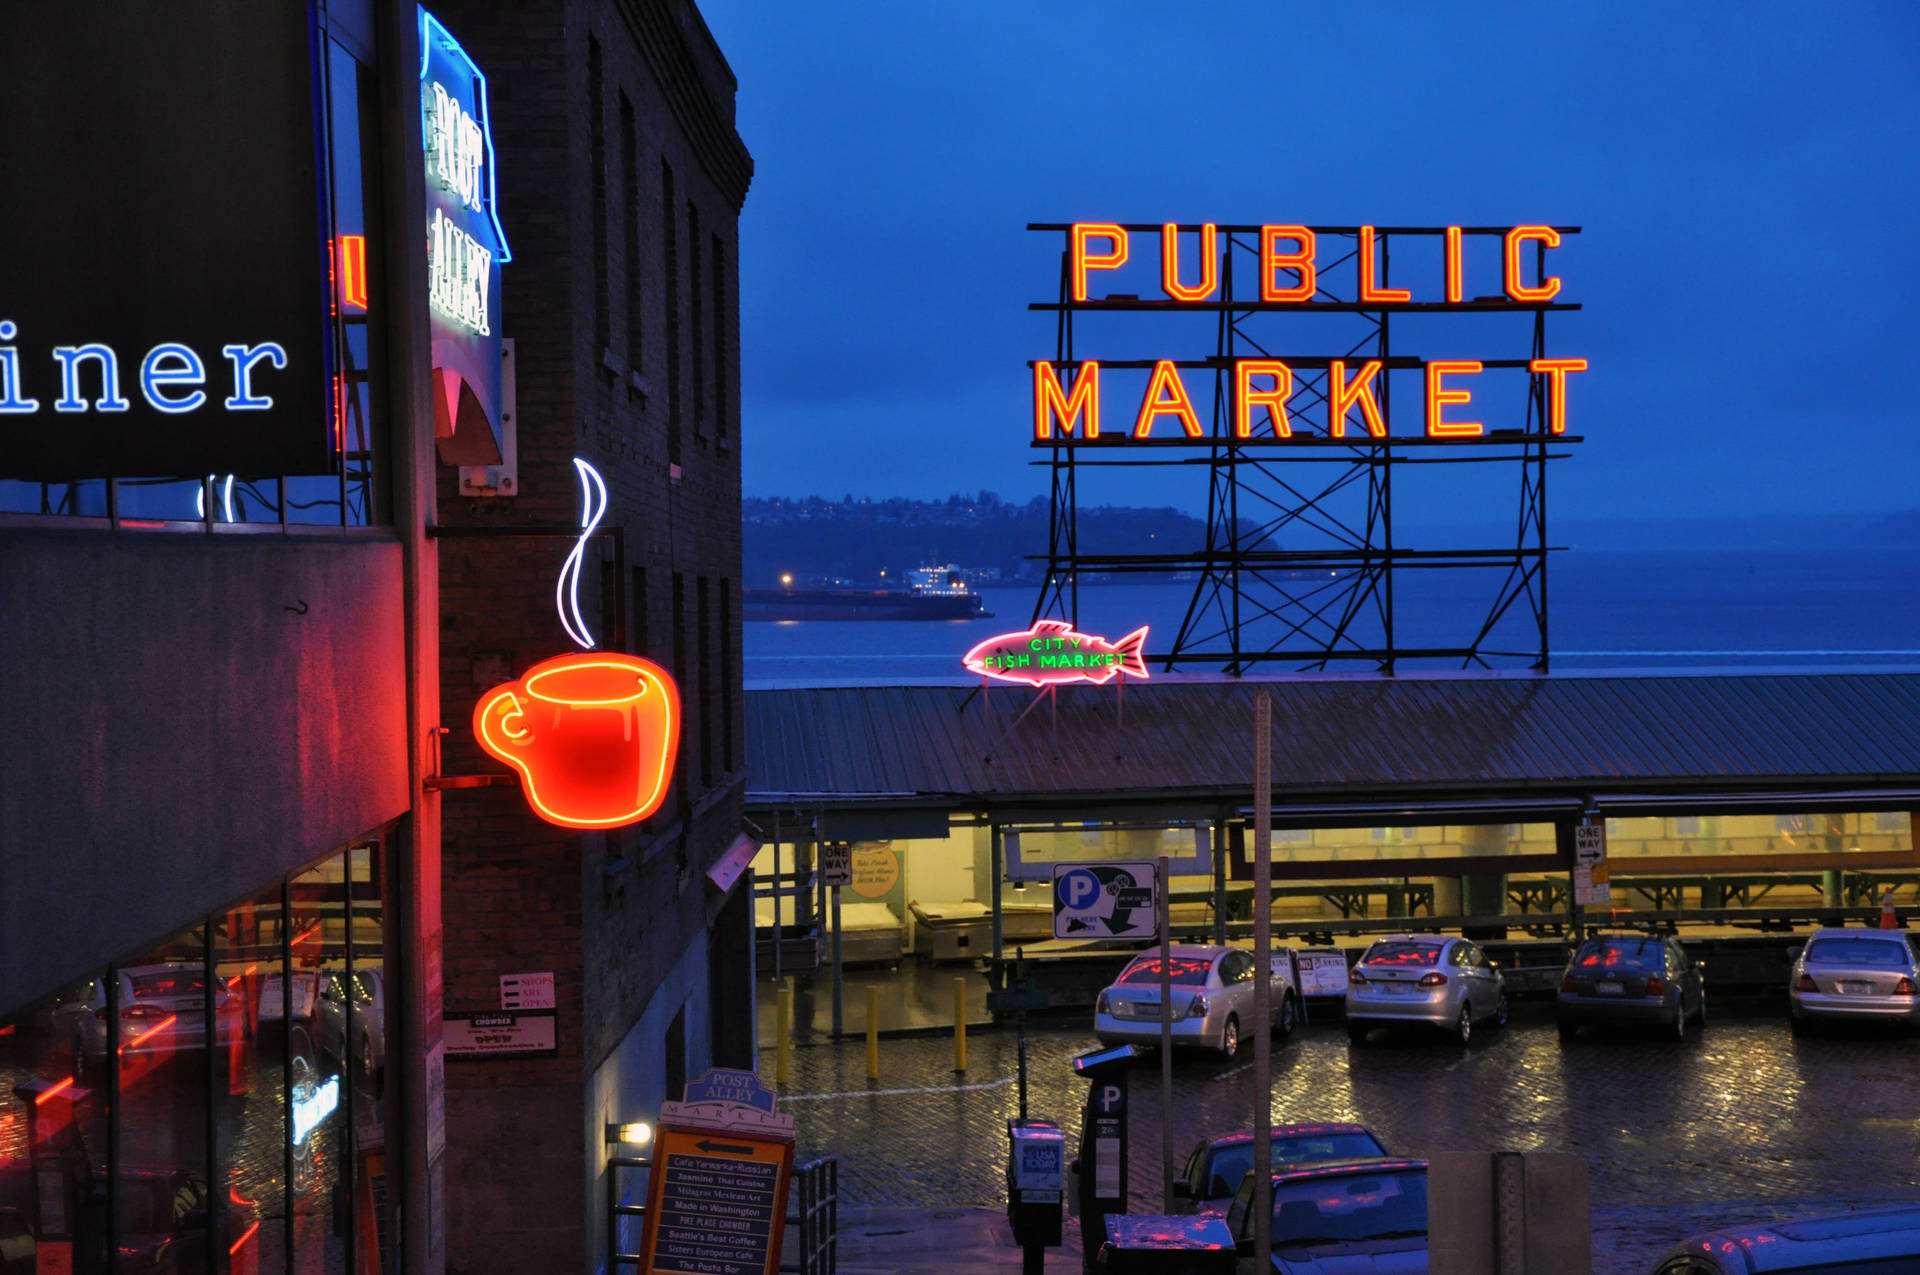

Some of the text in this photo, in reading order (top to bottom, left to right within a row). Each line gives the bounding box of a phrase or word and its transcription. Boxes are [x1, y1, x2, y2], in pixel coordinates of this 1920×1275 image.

[431, 80, 484, 213] POST
[1070, 222, 1562, 303] PUBLIC
[430, 207, 491, 337] ALLEY
[0, 319, 288, 415] iner
[1034, 358, 1588, 439] MARKET
[1029, 638, 1081, 651] CITY
[984, 652, 1127, 669] FISH MARKET
[1578, 827, 1600, 837] ONE
[1578, 840, 1600, 848] WAY
[825, 847, 849, 857] ONE
[825, 860, 849, 869] WAY
[1069, 876, 1093, 906] P
[1300, 959, 1345, 970] NO PARKING
[521, 976, 553, 987] SHOPS
[522, 999, 550, 1007] OPEN
[475, 1018, 512, 1026] CHOWDER
[475, 1035, 512, 1044] OPEN
[712, 1073, 753, 1089] POST
[705, 1086, 756, 1101] ALLEY
[666, 1105, 787, 1125] MARKET
[673, 1157, 694, 1167] Cafe
[1035, 1151, 1056, 1159] USA
[1026, 1160, 1057, 1169] TODAY
[677, 1173, 766, 1188] Jasmine Thai Cuisine
[677, 1186, 761, 1202] Milagros Mexican Art
[674, 1201, 760, 1217] Made in Washington
[680, 1216, 751, 1231] PIKE PLACE CHOWDER
[668, 1230, 757, 1246] Seattle's Best Coffee
[668, 1245, 754, 1260] Sisters European Cafe
[678, 1261, 695, 1269] The
[724, 1265, 741, 1274] Bar
